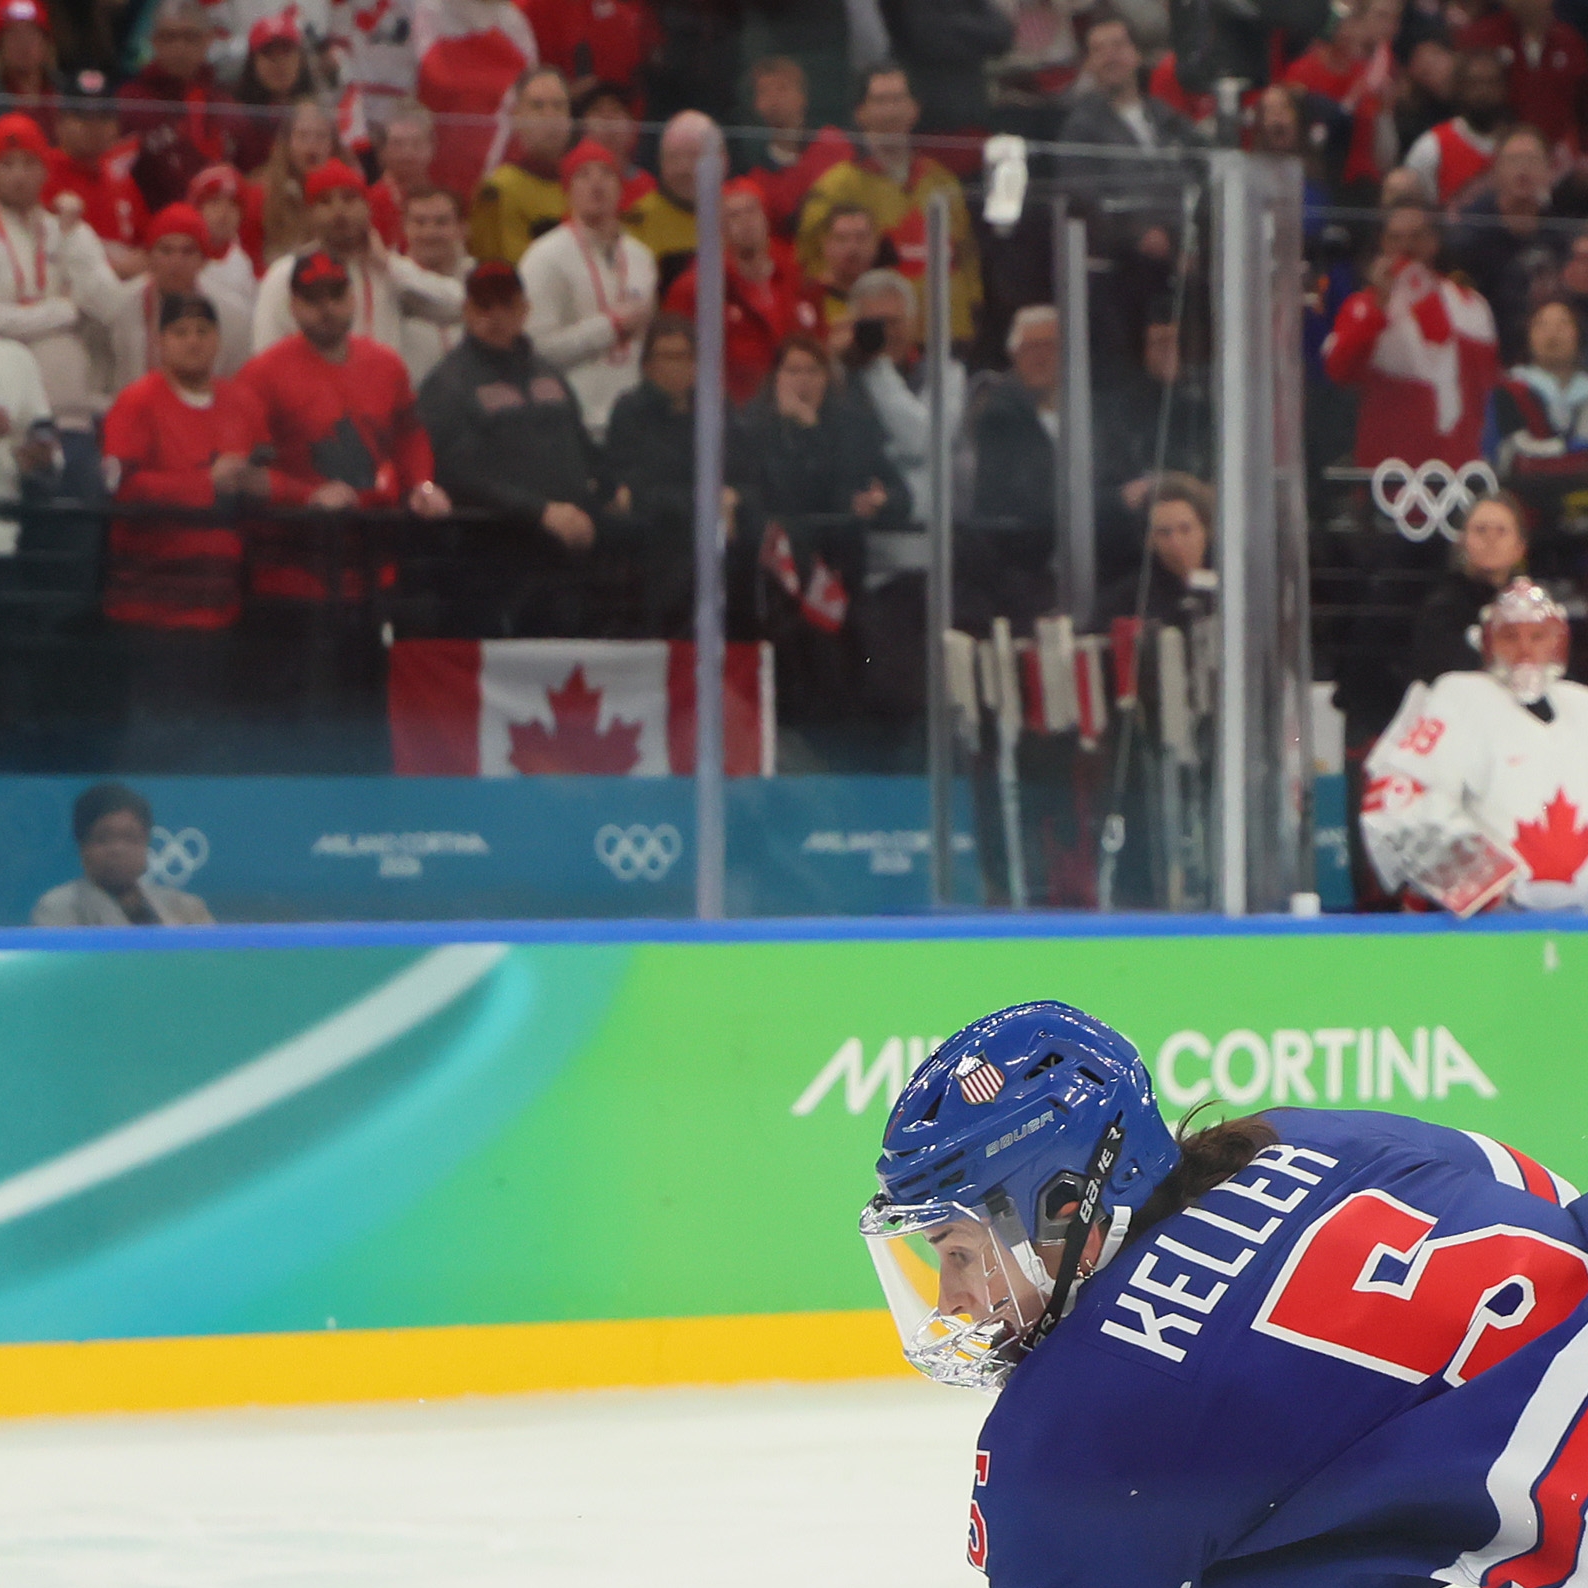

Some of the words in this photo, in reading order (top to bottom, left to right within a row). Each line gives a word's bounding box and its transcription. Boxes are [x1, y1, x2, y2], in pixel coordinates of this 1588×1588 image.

[1156, 1026, 1498, 1108] CORTINA
[985, 1110, 1056, 1159] BAUER
[1099, 1144, 1341, 1364] KELLER
